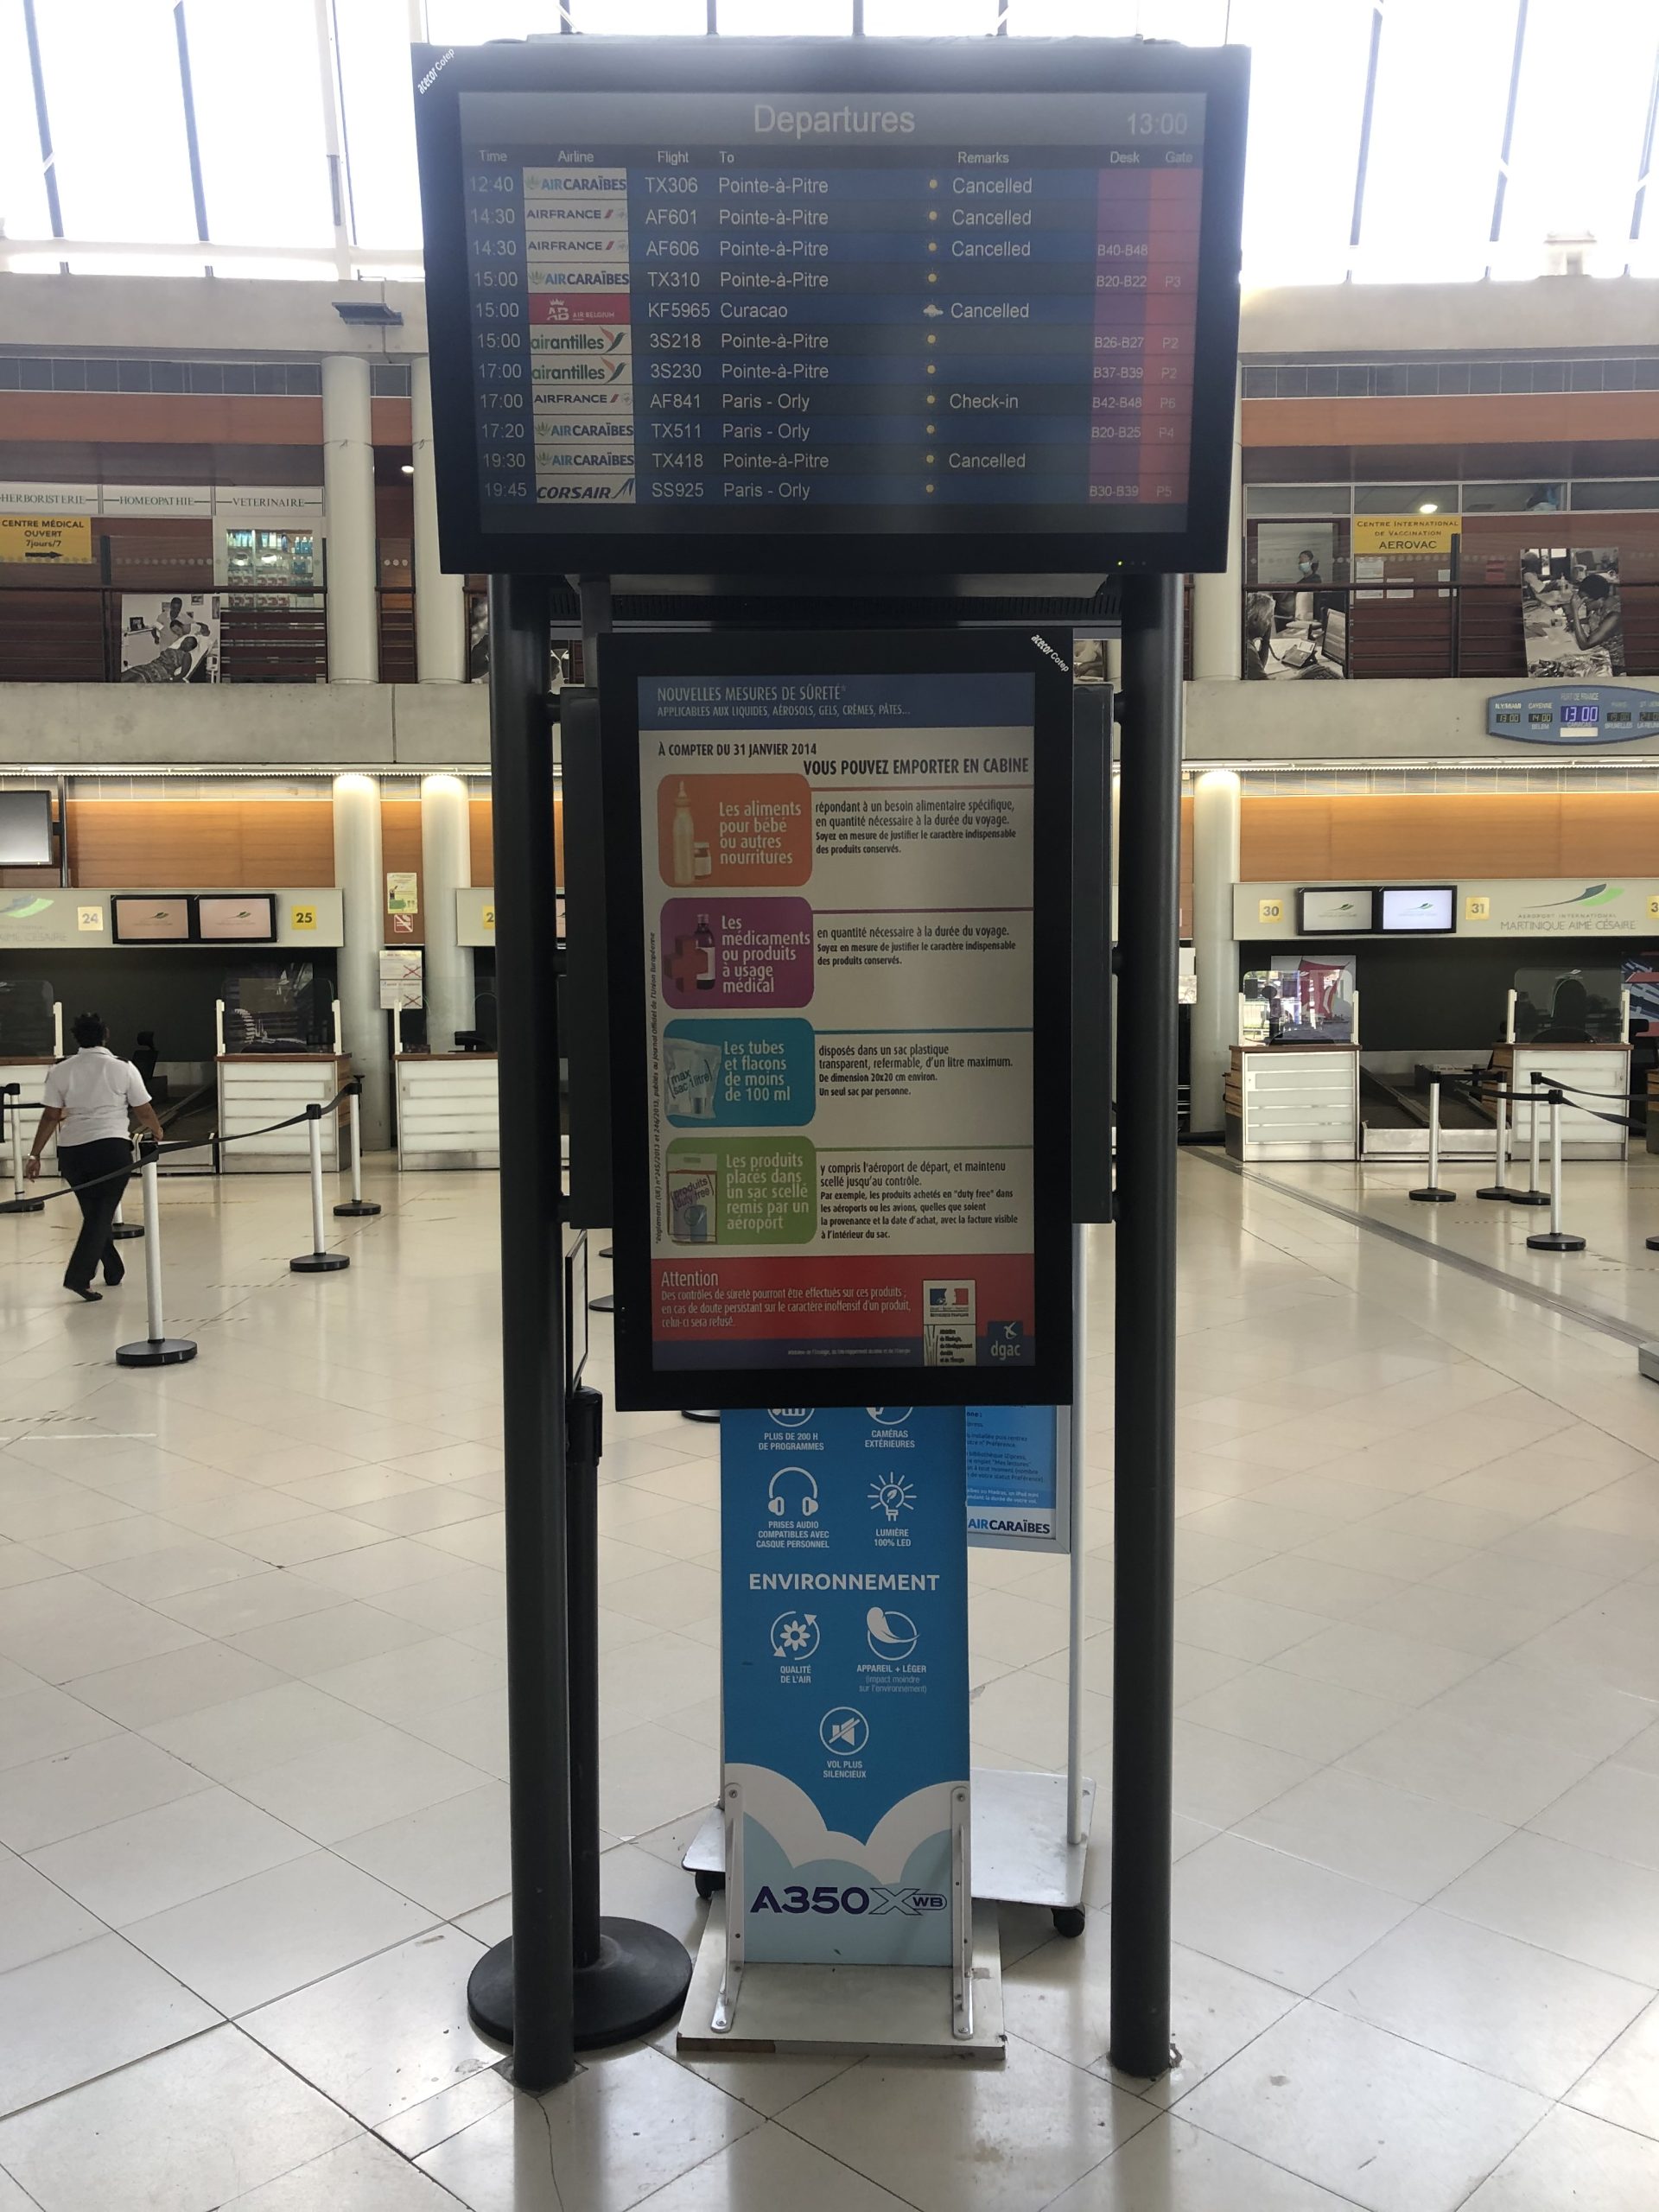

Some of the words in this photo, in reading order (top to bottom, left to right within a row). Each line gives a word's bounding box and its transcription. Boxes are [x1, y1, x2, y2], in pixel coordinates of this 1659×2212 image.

[753, 104, 916, 140] Departures
[1128, 112, 1187, 136] 13:00
[480, 149, 507, 162] Time
[558, 150, 594, 163] Airline
[658, 150, 689, 164] Flight
[720, 151, 734, 163] To
[957, 152, 1009, 163] Remarks
[1110, 152, 1140, 163] Desk
[1166, 152, 1192, 163] Gate
[470, 177, 513, 193] 12:40
[645, 177, 697, 193] TX306
[719, 177, 829, 194] Pointe-à-Pitre
[953, 177, 1032, 194] Cancelled
[471, 209, 515, 224] 14:30
[645, 209, 697, 225] AF601
[720, 210, 829, 226] Pointe-à-Pitre
[953, 210, 1032, 226] Cancelled
[474, 241, 516, 256] 14:30
[646, 241, 699, 257] AF606
[720, 241, 829, 257] Pointe-à-Pitre
[951, 241, 1031, 257] Cancelled
[1098, 245, 1147, 256] B40-B48
[476, 303, 518, 318] 15:00
[648, 302, 710, 318] KF5965
[721, 303, 788, 318] Curacao
[951, 303, 1029, 319] Cancelled
[478, 334, 520, 348] 15:00
[650, 334, 701, 348] 3S218
[721, 334, 829, 349] Pointe-à-Pitre
[1095, 337, 1144, 348] B26-B27
[1163, 338, 1179, 349] P2
[480, 394, 523, 409] 17:00
[651, 394, 700, 409] AF841
[722, 394, 762, 409] Paris
[779, 394, 809, 412] Orly
[950, 393, 1019, 409] Check-in
[1093, 397, 1141, 408] B42-B48
[1160, 397, 1175, 409] P6
[484, 483, 526, 497] 19:45
[537, 486, 611, 499] CORSAIR
[652, 483, 704, 497] SS925
[724, 483, 762, 498] Paris
[779, 482, 810, 500] Orly
[1090, 486, 1138, 496] B30-B39
[1157, 486, 1172, 497] P5
[1, 493, 86, 504] HERBORISTERIE
[119, 496, 194, 505] HOMEOPATHIE
[41, 519, 84, 528] MÉDICAL
[658, 687, 721, 702] NOUVELLES
[725, 687, 777, 701] MESURES
[782, 687, 795, 701] DE
[658, 705, 710, 717] APPLICABLES
[713, 706, 729, 716] AUX
[732, 705, 769, 718] LIQUIDES,
[772, 702, 816, 717] AÉROSOLS,
[818, 705, 840, 717] GELS,
[658, 741, 665, 756] À
[669, 744, 713, 756] COMPTER
[716, 744, 730, 756] DU
[734, 744, 746, 756] 31
[748, 743, 788, 757] JANVIER
[791, 743, 817, 755] 2014
[804, 760, 836, 775] VOUS
[842, 760, 888, 775] POUVEZ
[893, 759, 959, 774] EMPORTER
[963, 759, 979, 773] EN
[983, 758, 1028, 773] CABINE
[720, 802, 741, 817] Les
[744, 800, 801, 817] aliments
[720, 819, 751, 836] pour
[754, 817, 787, 833] bébé
[720, 836, 736, 849] ou
[740, 835, 781, 849] autres
[720, 850, 792, 865] nourritures
[1263, 906, 1279, 916] 30
[1471, 903, 1484, 913] 31
[1651, 902, 1659, 912] 3
[82, 913, 98, 924] 24
[296, 912, 312, 924] 25
[486, 912, 494, 922] 2
[1501, 921, 1564, 931] MARTINIQUE
[1569, 919, 1592, 930] AIMÉ
[1596, 919, 1636, 930] CÉSAIRE
[661, 1271, 718, 1287] Attention
[991, 1341, 1020, 1360] dgac
[764, 1433, 783, 1441] PLUS
[872, 1429, 908, 1438] CAMÉRAS
[759, 1442, 769, 1451] DE
[772, 1442, 823, 1451] PROGRAMMES
[865, 1439, 915, 1448] EXTÉRIEURES
[768, 1521, 793, 1529] PRISES
[759, 1530, 807, 1539] COMPATIBLES
[810, 1530, 830, 1539] AVEC
[876, 1528, 909, 1537] LUMIÈRE
[787, 1540, 830, 1548] PERSONNEL
[874, 1538, 894, 1547] 100%
[898, 1538, 911, 1547] LED
[750, 1573, 939, 1591] ENVIRONNEMENT
[781, 1665, 811, 1674] QUALITÉ
[857, 1664, 893, 1673] APPAREIL
[903, 1663, 926, 1673] LÉGER
[794, 1675, 810, 1683] L'AIR
